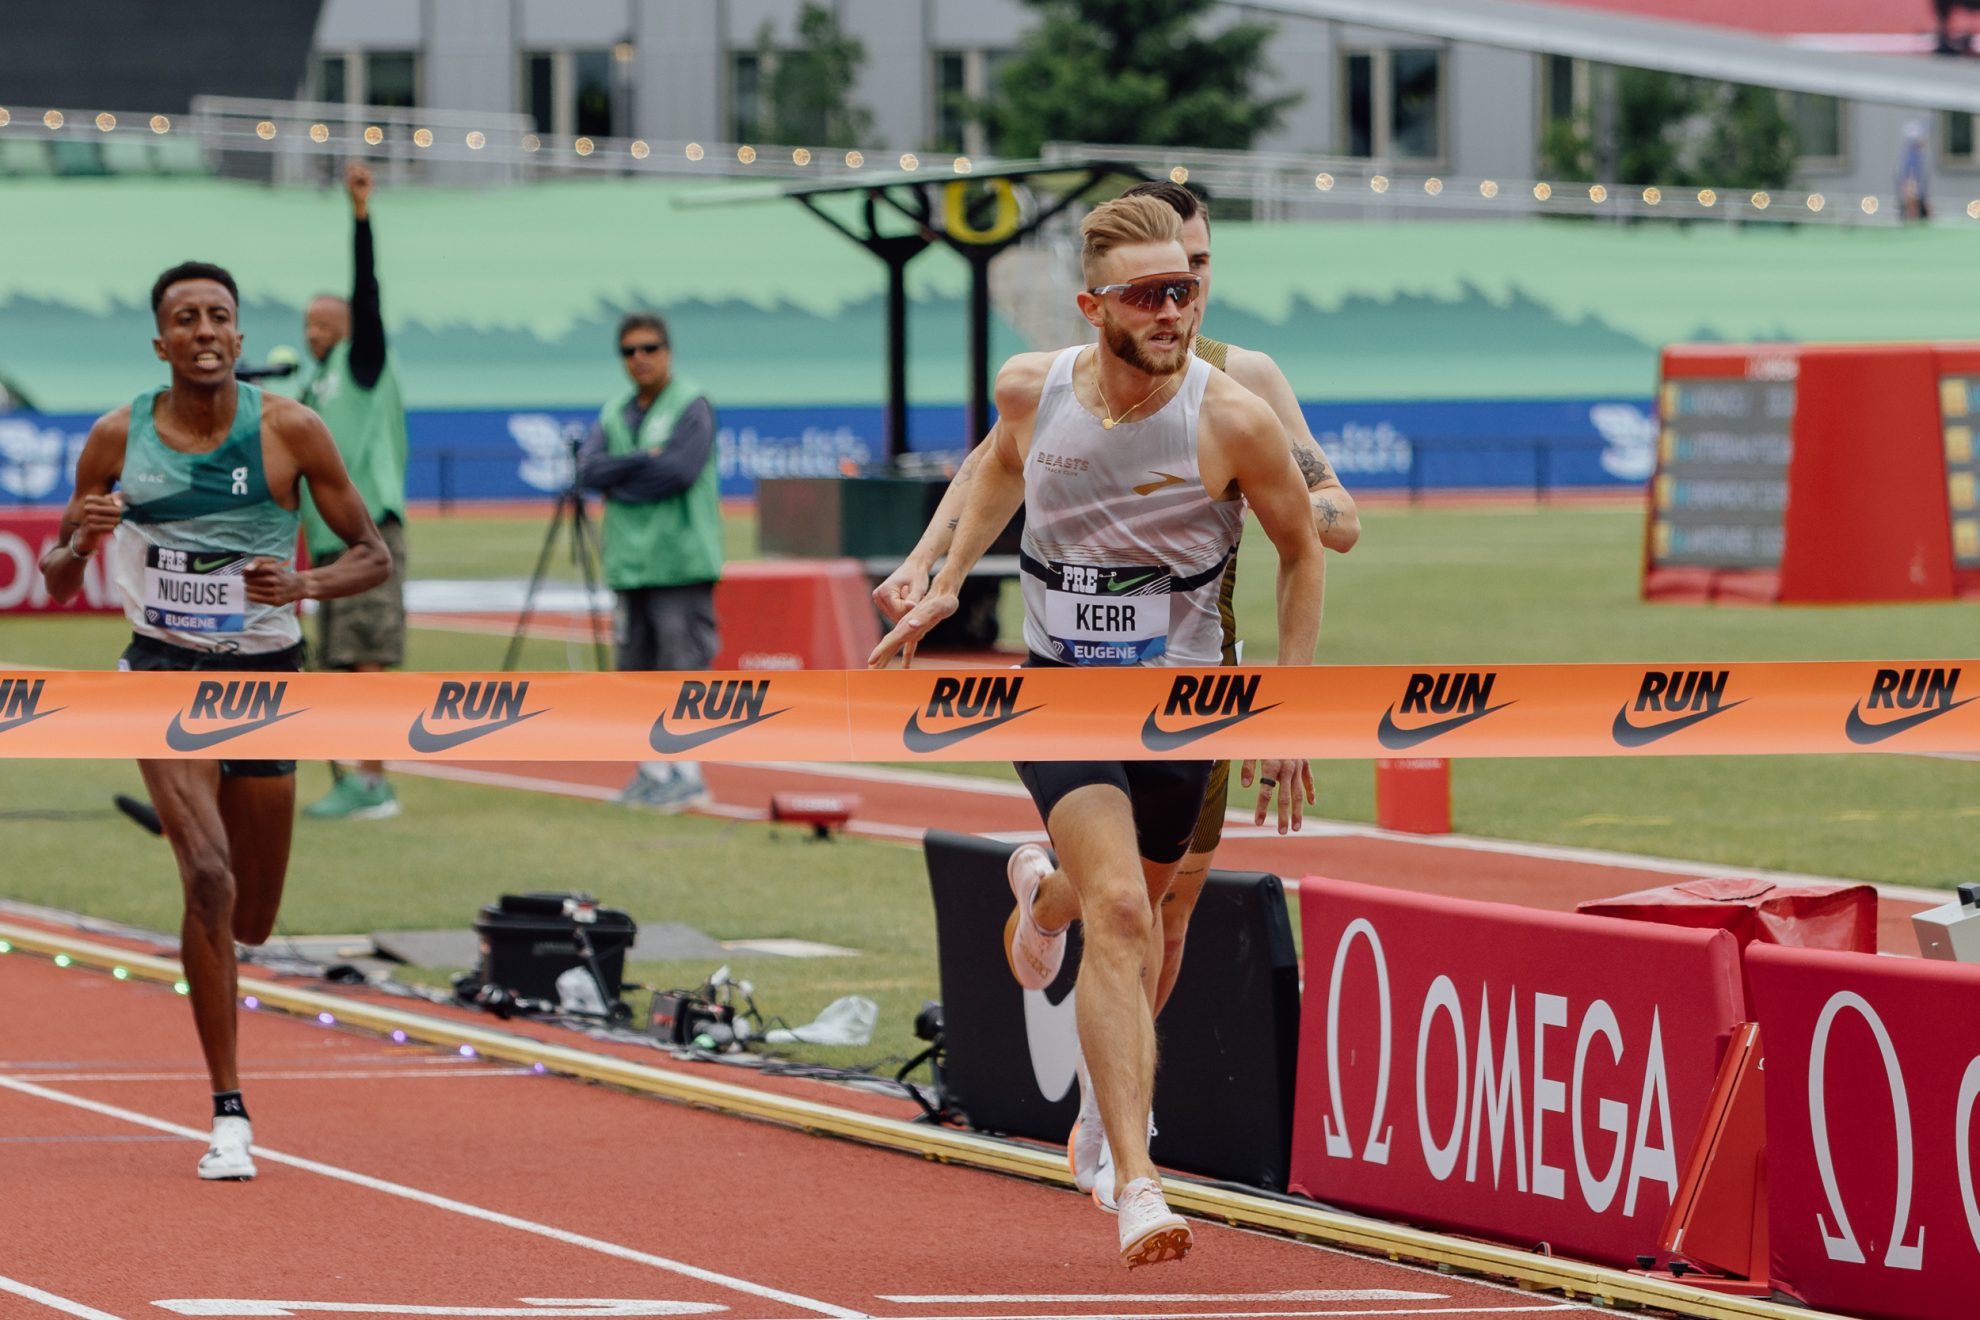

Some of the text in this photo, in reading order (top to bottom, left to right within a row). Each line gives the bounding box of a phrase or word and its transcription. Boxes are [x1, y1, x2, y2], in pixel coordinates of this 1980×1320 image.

[1036, 451, 1089, 472] BEASTS
[158, 548, 188, 573] PRE
[1062, 565, 1099, 594] PRE
[158, 577, 229, 605] NUGUSE
[165, 614, 217, 629] EUGENE
[1076, 603, 1136, 632] KERR
[1074, 645, 1137, 659] EUGENE
[188, 680, 288, 720] RUN
[431, 681, 530, 720] RUN
[672, 680, 770, 720] RUN
[925, 677, 1024, 718] RUN
[1164, 675, 1262, 716] RUN
[1399, 673, 1497, 714] RUN
[1634, 671, 1729, 712] RUN
[1867, 669, 1961, 709] RUN
[1415, 974, 1679, 1217] OMEGA
